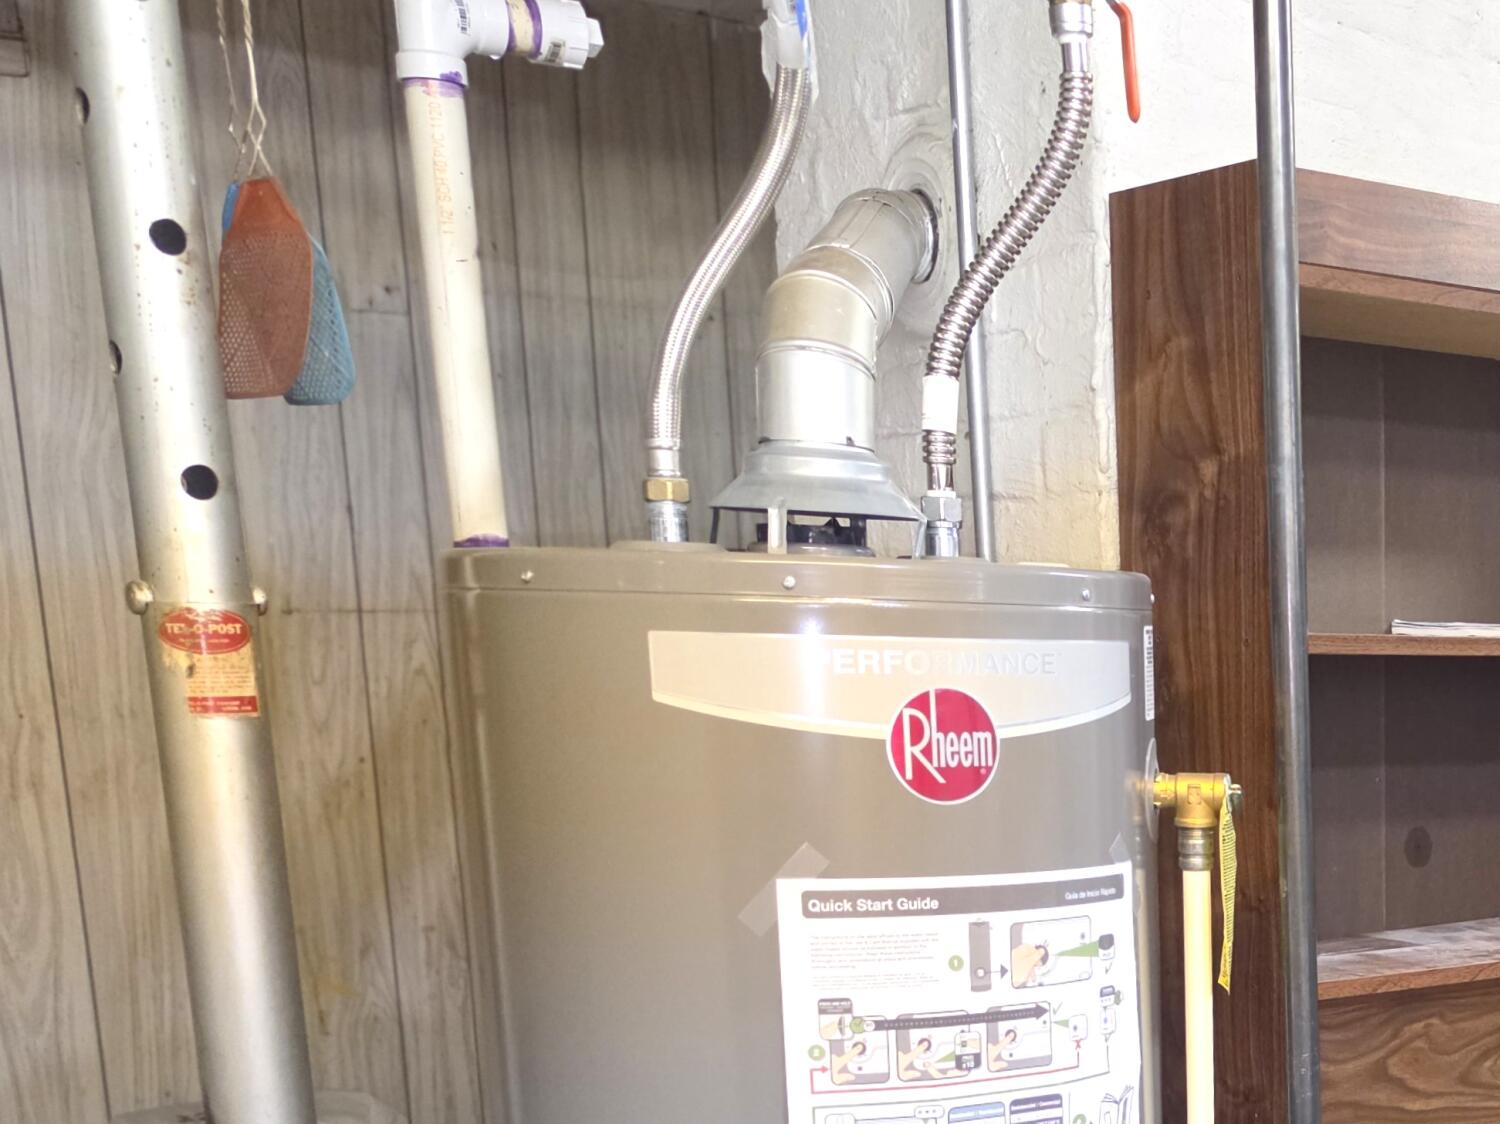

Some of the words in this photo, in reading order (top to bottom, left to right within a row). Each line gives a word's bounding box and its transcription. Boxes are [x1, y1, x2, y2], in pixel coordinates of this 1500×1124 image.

[903, 688, 993, 783] Rheem
[808, 899, 852, 913] Quick
[856, 898, 893, 911] Start
[896, 897, 939, 910] Guide
